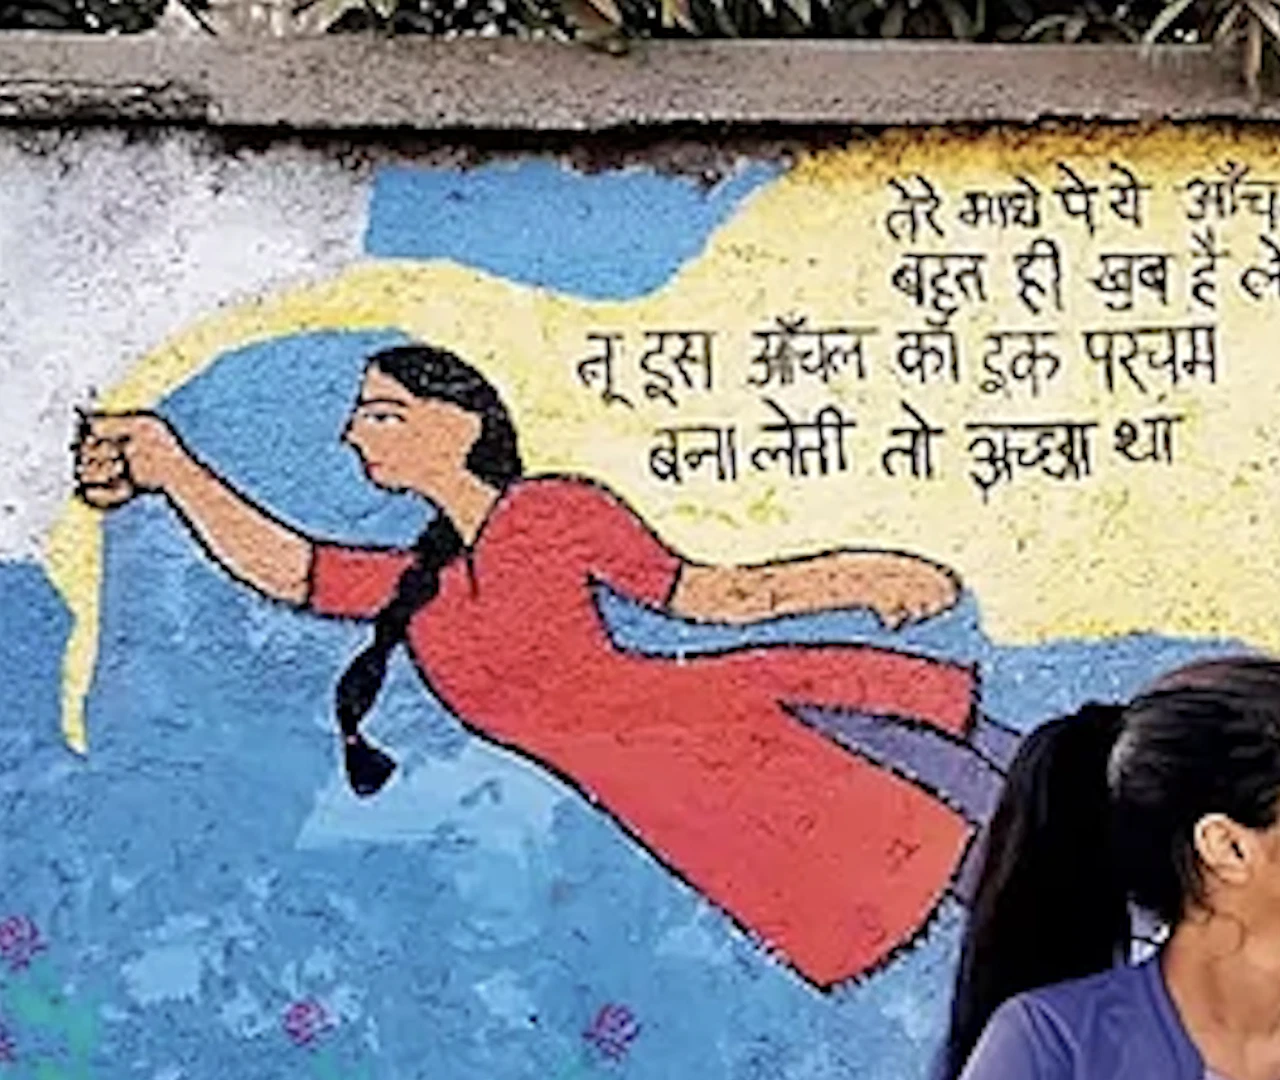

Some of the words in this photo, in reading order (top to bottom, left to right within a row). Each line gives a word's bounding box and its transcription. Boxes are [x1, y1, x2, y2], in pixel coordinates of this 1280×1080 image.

[887, 174, 944, 243] तेरे
[1053, 162, 1098, 237] पे
[1107, 162, 1152, 227] ये
[892, 253, 986, 322] बहुत
[1013, 238, 1065, 314] ही
[1189, 228, 1230, 309] है
[577, 332, 634, 409] तू
[1081, 326, 1217, 393] परचम
[649, 424, 737, 484] बना
[750, 398, 857, 478] लेती
[880, 400, 945, 480] तो
[965, 422, 1100, 504] अच्छा
[1113, 414, 1184, 465] था
